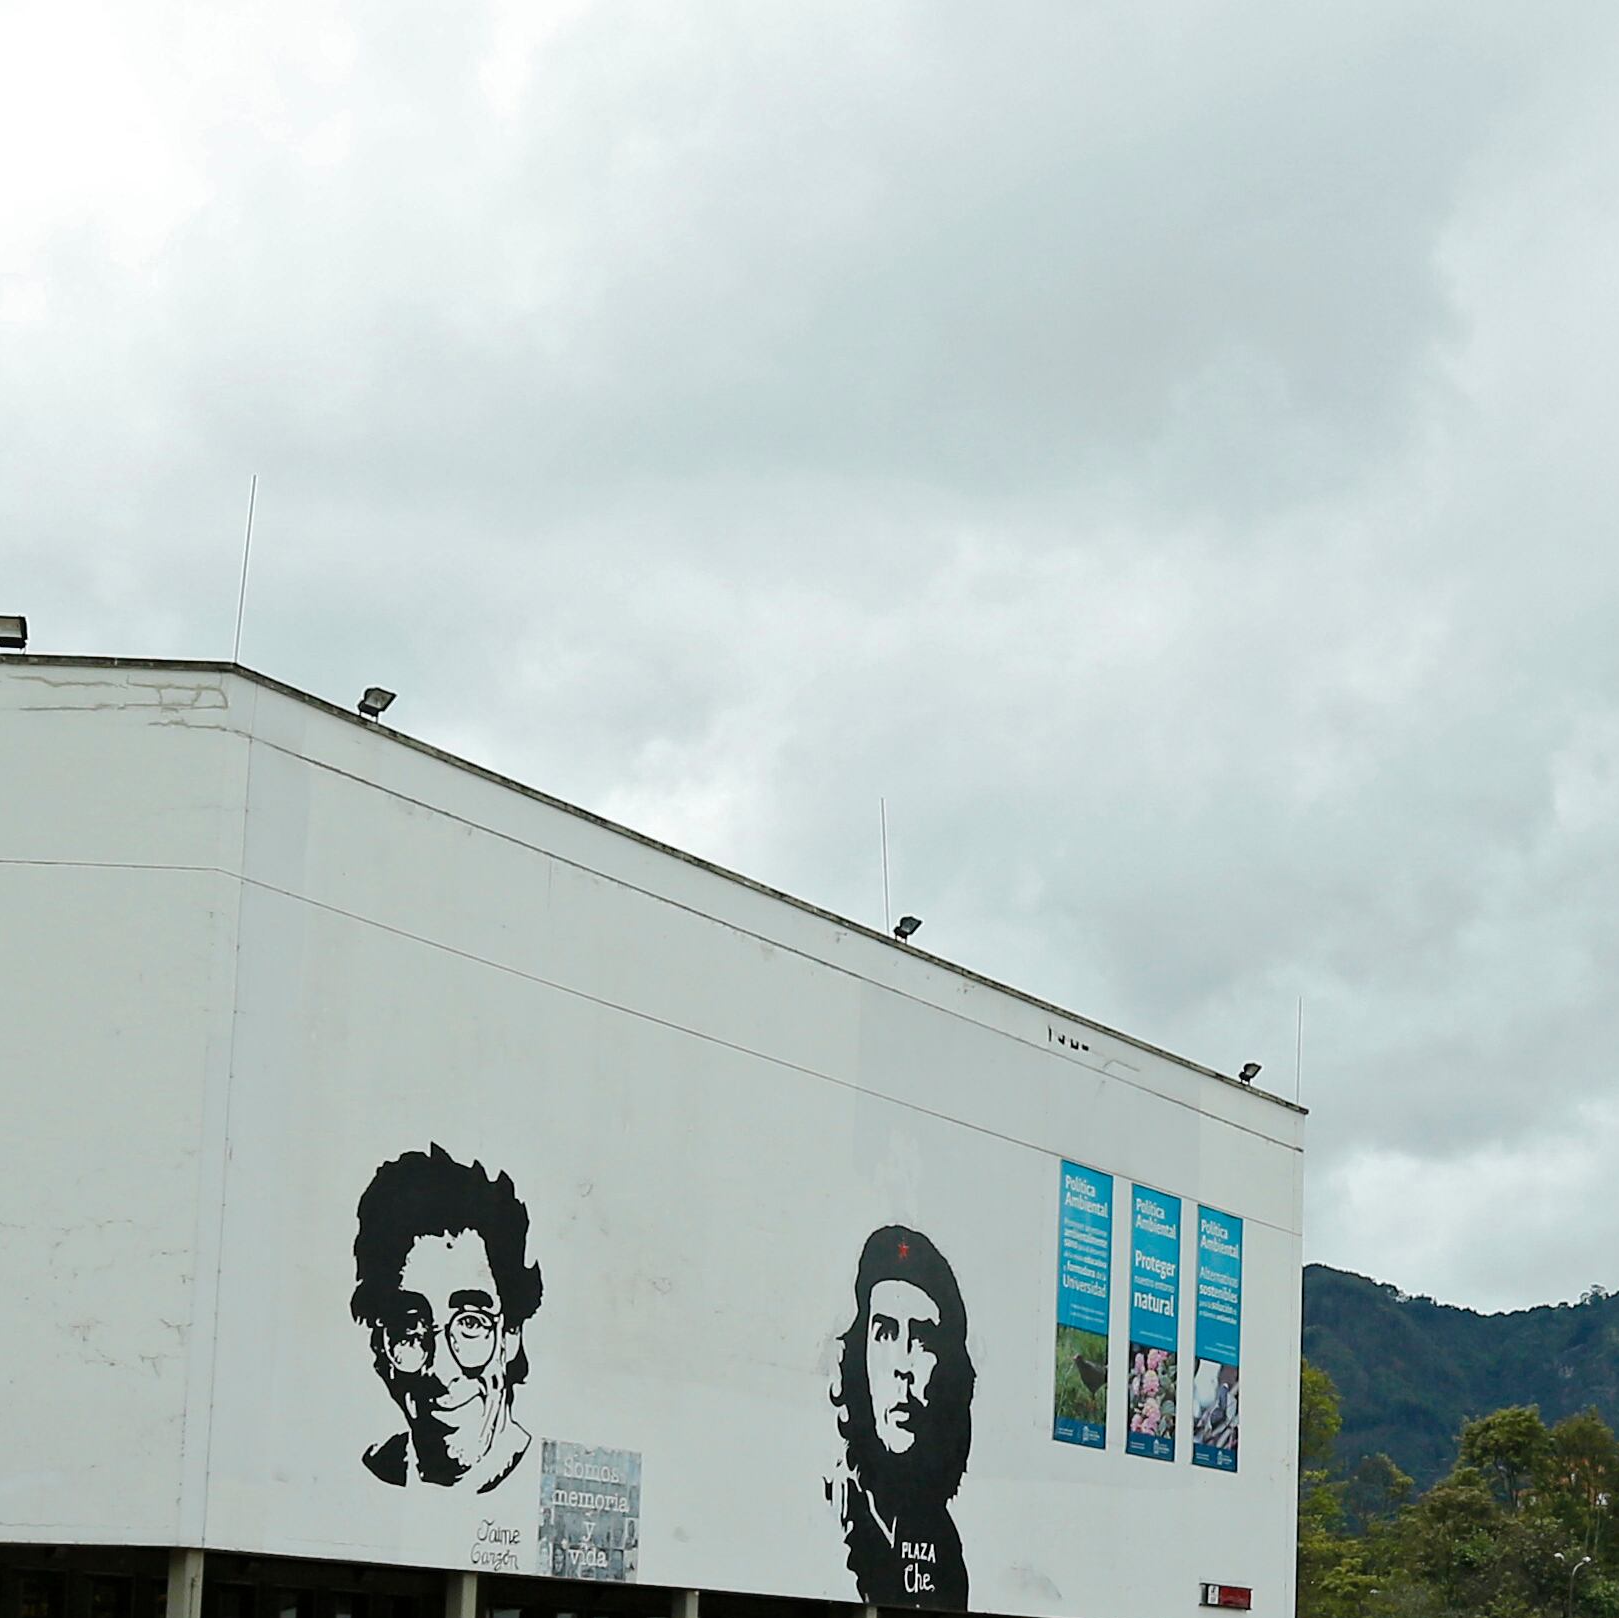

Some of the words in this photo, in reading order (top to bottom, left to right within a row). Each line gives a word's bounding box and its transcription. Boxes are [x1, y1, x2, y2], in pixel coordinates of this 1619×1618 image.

[1065, 1174, 1096, 1198] Política
[1065, 1191, 1109, 1218] Ambiental
[1136, 1198, 1166, 1220] Política
[1136, 1214, 1177, 1240] Ambiental
[1201, 1219, 1228, 1240] Política
[1200, 1234, 1240, 1259] Ambiental
[1135, 1249, 1176, 1280] Proteger
[1063, 1273, 1107, 1298] Universidad
[1134, 1291, 1175, 1317] natural
[563, 1457, 620, 1483] Somos
[552, 1489, 630, 1514] memoria
[477, 1519, 521, 1545] Jaime
[583, 1521, 596, 1542] y
[470, 1543, 519, 1571] Garzón
[567, 1544, 608, 1568] vida
[901, 1541, 936, 1564] PLAZA
[904, 1562, 935, 1593] Che
